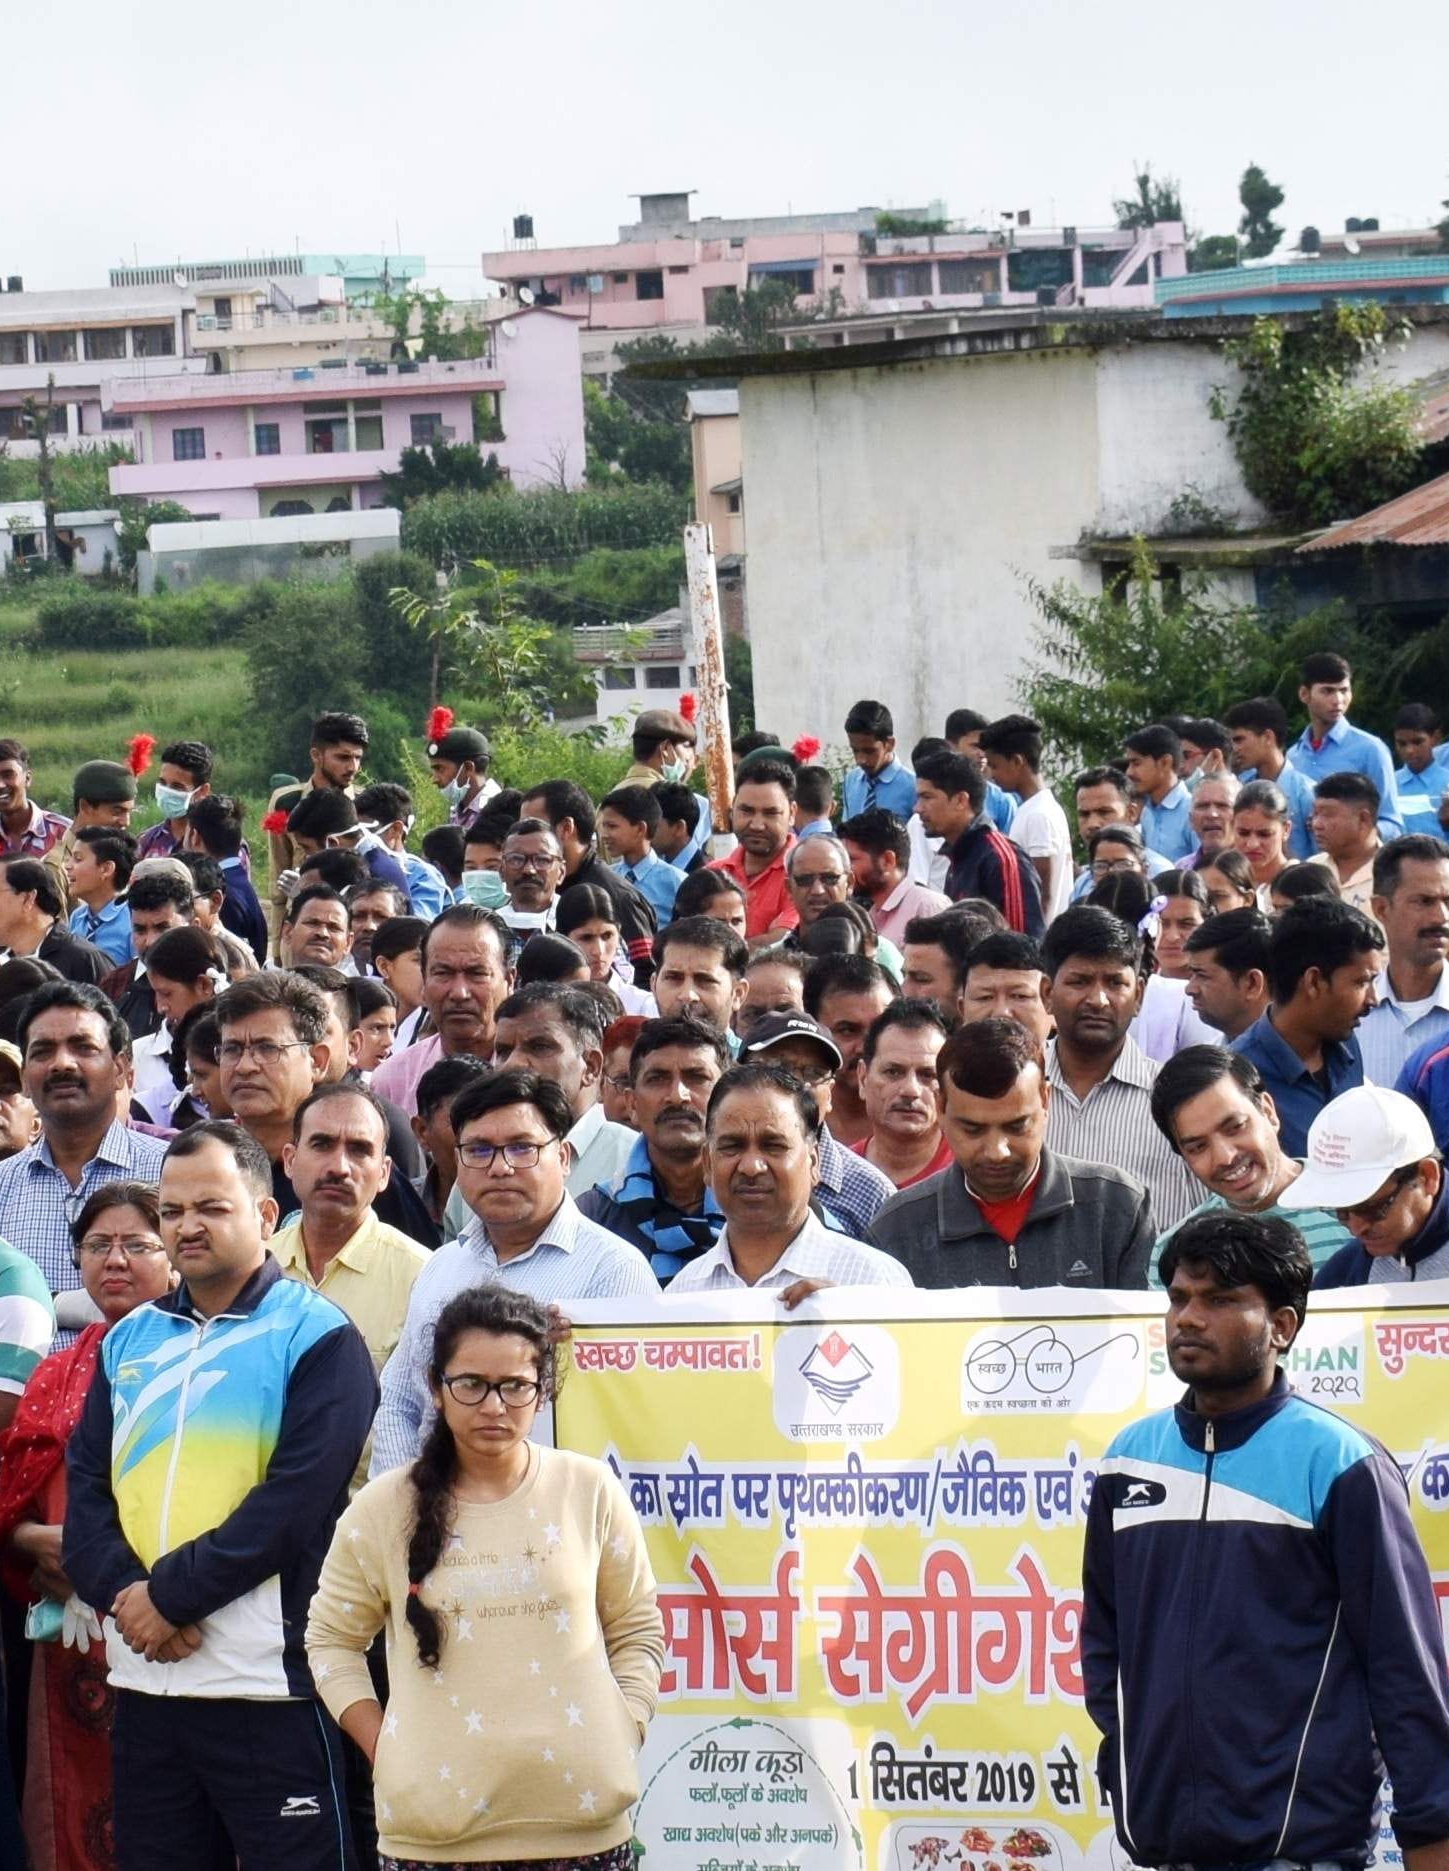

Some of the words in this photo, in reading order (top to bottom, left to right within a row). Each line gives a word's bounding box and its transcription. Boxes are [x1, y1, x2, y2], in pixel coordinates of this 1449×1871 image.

[574, 1341, 638, 1370] स्वच्छ
[1036, 1362, 1062, 1374] भारत
[1311, 1376, 1360, 1398] 2020
[848, 1423, 884, 1437] सरकार
[732, 1474, 771, 1518] पर
[1034, 1451, 1074, 1520] एवं
[689, 1740, 750, 1773] गीला
[755, 1750, 804, 1784] कूड़ा
[870, 1741, 968, 1801] सितंबर
[976, 1761, 1035, 1803] 2019
[1047, 1744, 1081, 1804] से
[751, 1783, 764, 1802] के
[767, 1783, 808, 1804] अवशेष
[764, 1823, 787, 1843] और
